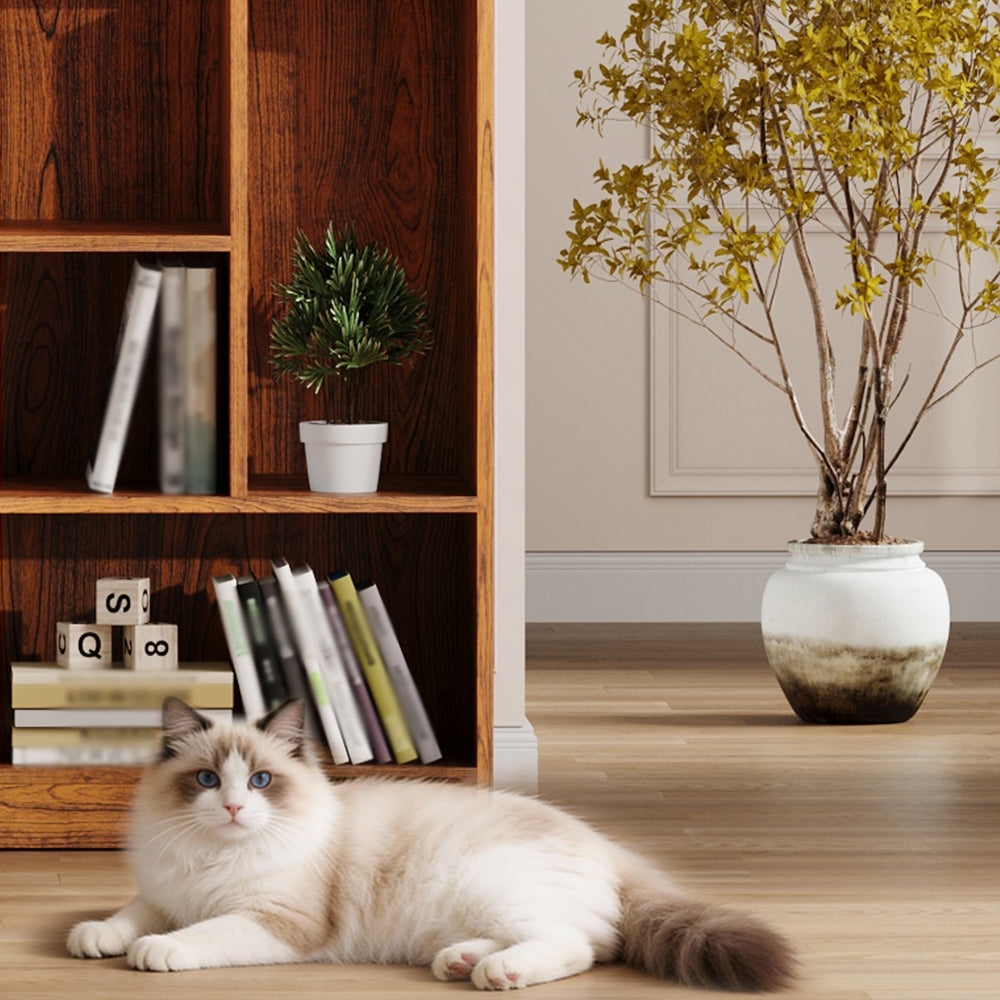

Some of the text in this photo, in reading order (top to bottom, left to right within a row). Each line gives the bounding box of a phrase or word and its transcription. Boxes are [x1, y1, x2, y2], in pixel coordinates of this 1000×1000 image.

[105, 592, 131, 614] S
[77, 631, 102, 659] Q
[144, 639, 169, 657] 8
